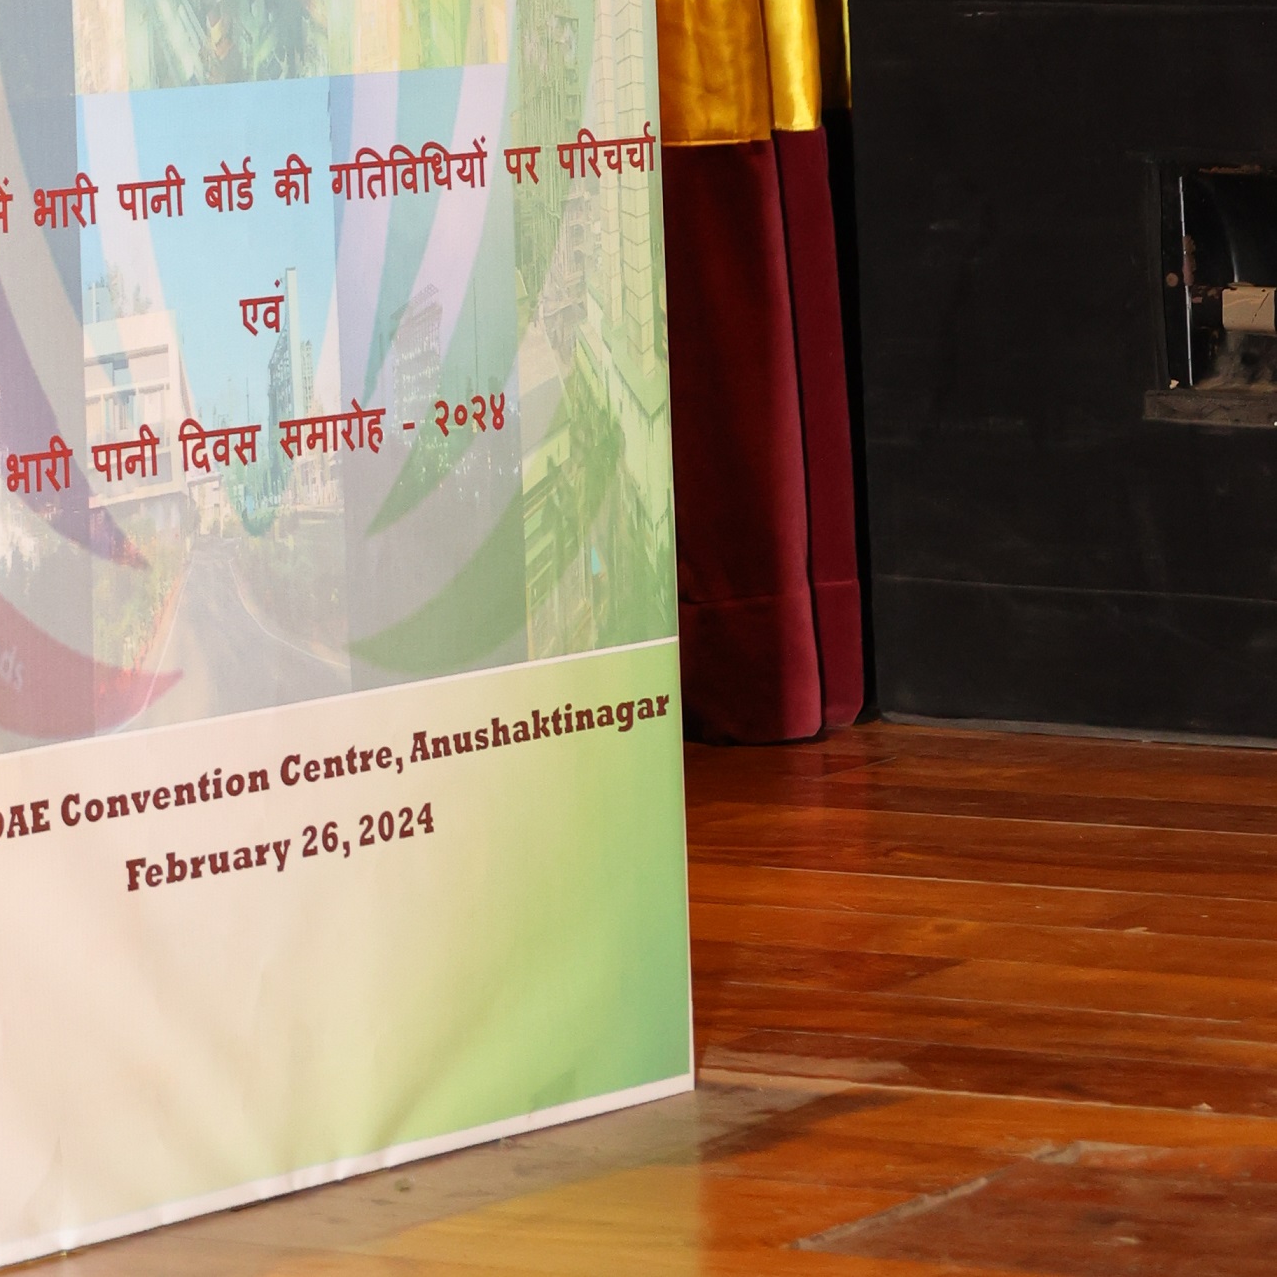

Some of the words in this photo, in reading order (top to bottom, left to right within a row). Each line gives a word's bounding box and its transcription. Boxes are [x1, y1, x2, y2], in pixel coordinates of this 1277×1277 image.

[33, 172, 99, 228] भारी
[117, 164, 186, 221] पानी
[203, 156, 256, 212] बोर्ड
[274, 153, 312, 205] की
[329, 135, 488, 200] गतिविधियों
[503, 146, 542, 183] पर
[556, 121, 656, 179] परिचर्चा
[239, 277, 284, 335] एवं
[6, 435, 73, 494] भारी
[90, 423, 161, 483] पानी
[178, 417, 262, 473] दिवस
[278, 398, 387, 459] समारोह
[402, 422, 416, 430] -
[434, 393, 505, 436] २०२४
[60, 767, 270, 827] Convention
[279, 745, 404, 787] Centre,
[409, 694, 670, 764] Anushaktinagar
[125, 838, 291, 892] February
[302, 821, 351, 859] 26,
[358, 802, 435, 847] 2024
